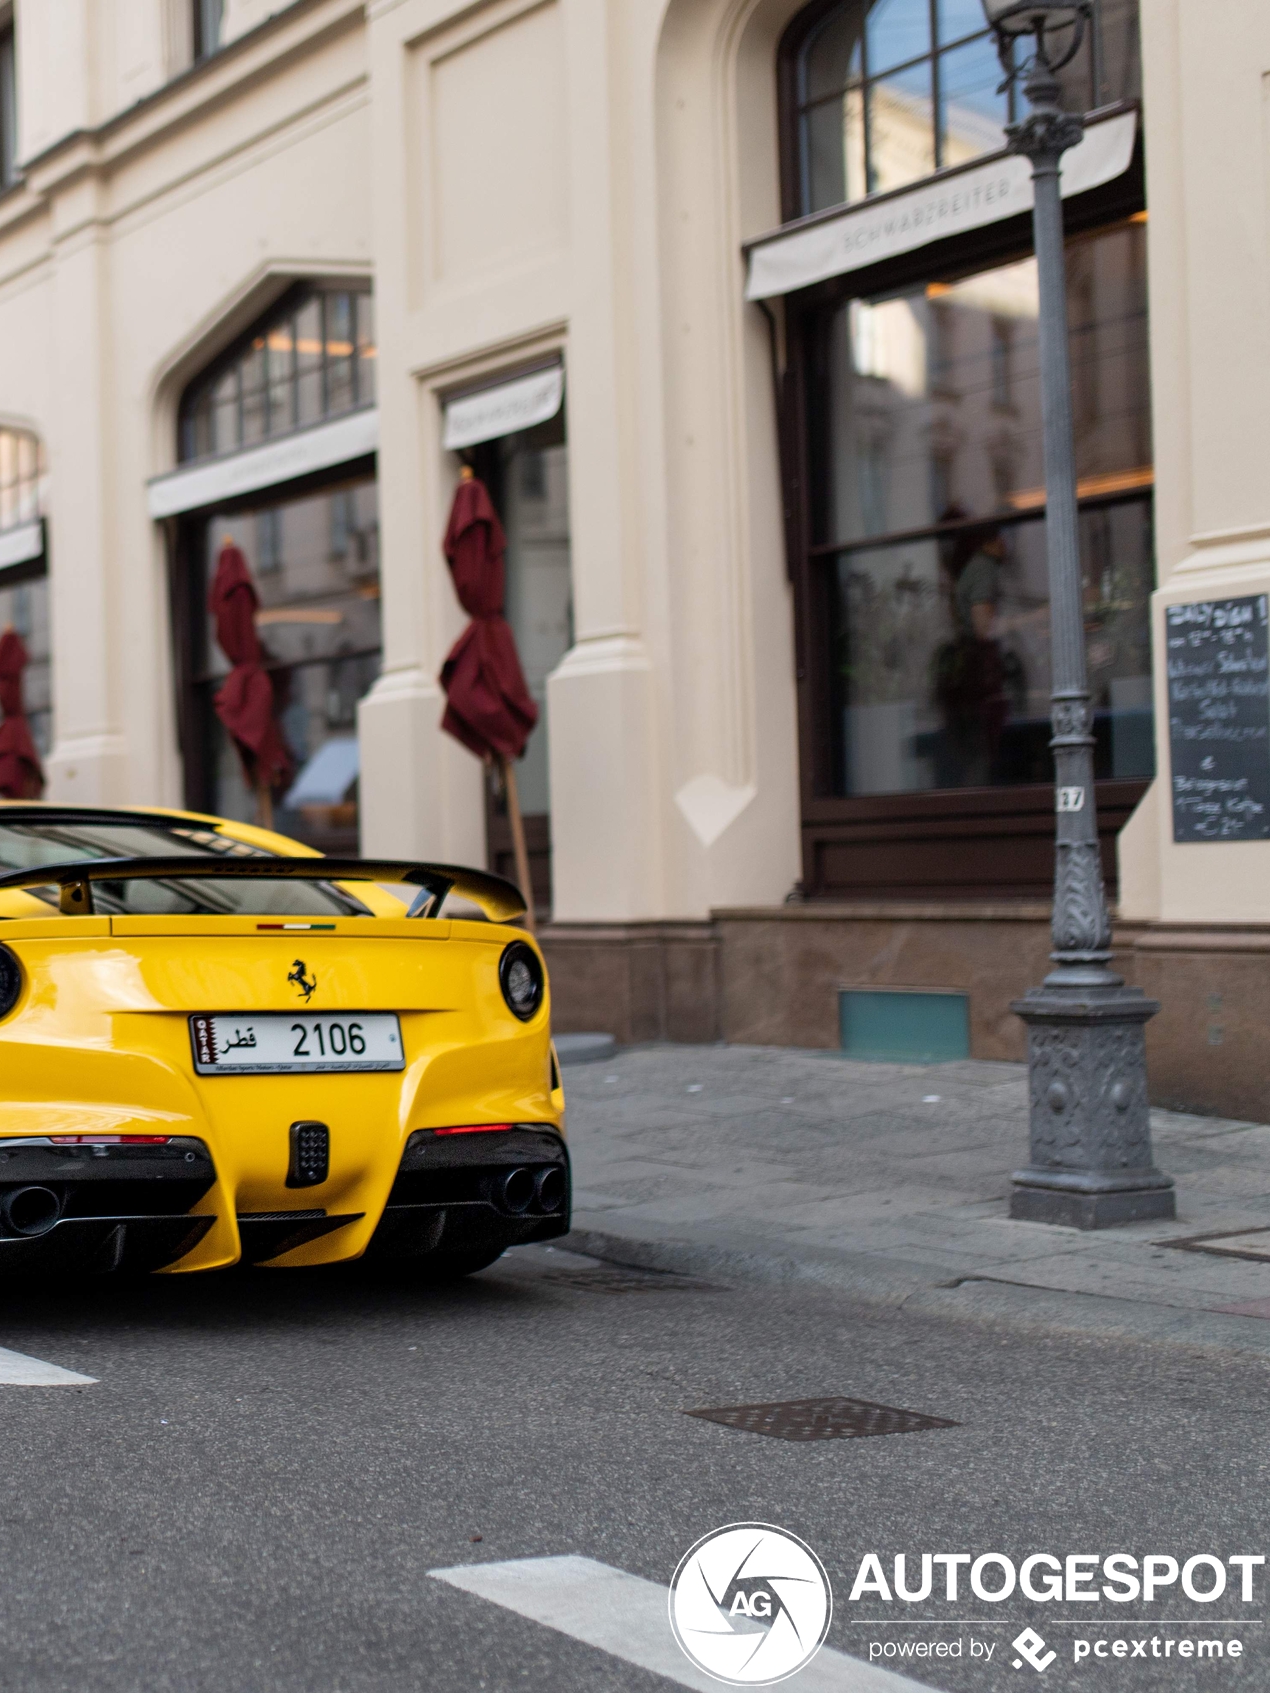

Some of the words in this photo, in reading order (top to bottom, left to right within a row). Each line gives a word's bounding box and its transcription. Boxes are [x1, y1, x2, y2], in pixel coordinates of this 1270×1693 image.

[197, 1019, 211, 1063] QATAR
[220, 1027, 257, 1054] قطر
[291, 1022, 366, 1056] 2106
